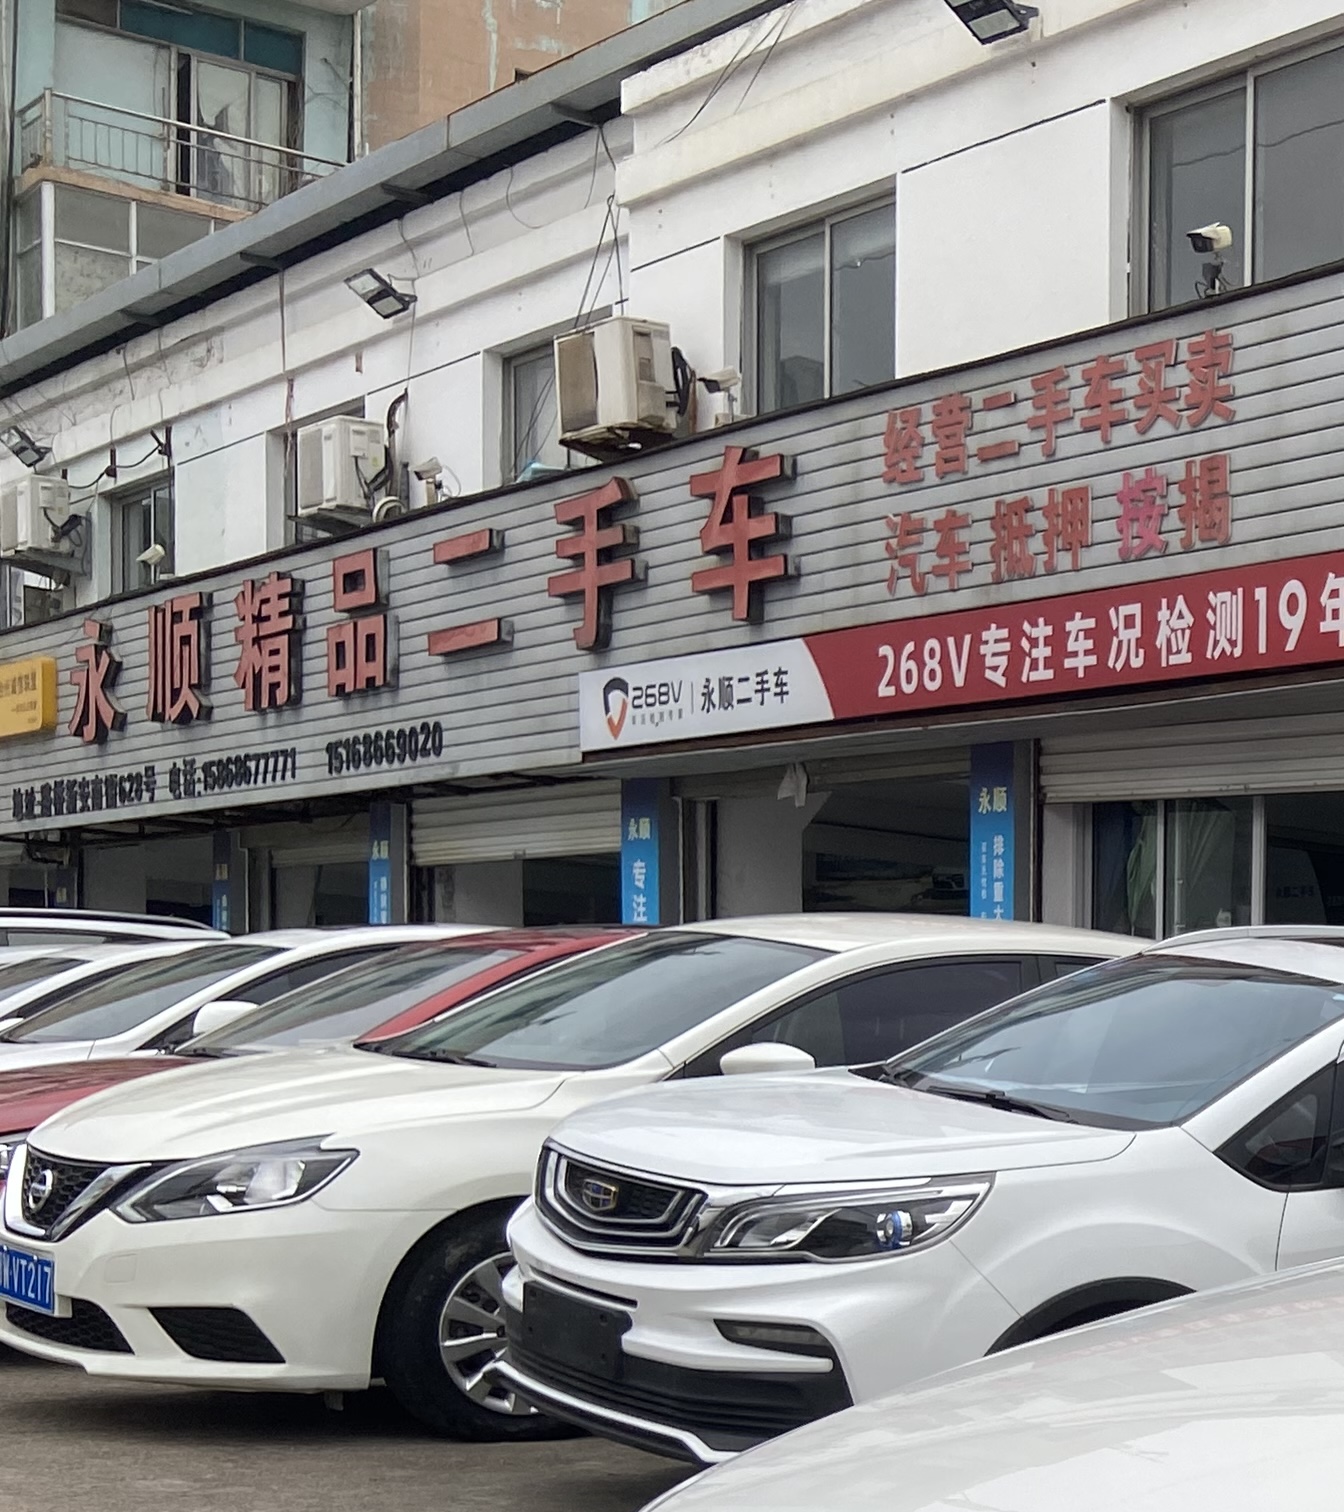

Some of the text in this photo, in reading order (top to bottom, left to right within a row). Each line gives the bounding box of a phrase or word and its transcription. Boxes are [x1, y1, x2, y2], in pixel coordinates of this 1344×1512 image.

[883, 329, 1236, 485] 经营二手车买卖
[66, 446, 792, 744] 永顺精品二手车
[631, 679, 683, 710] 268V
[700, 666, 790, 714] 永顺二手车
[978, 786, 1008, 815] 永顺
